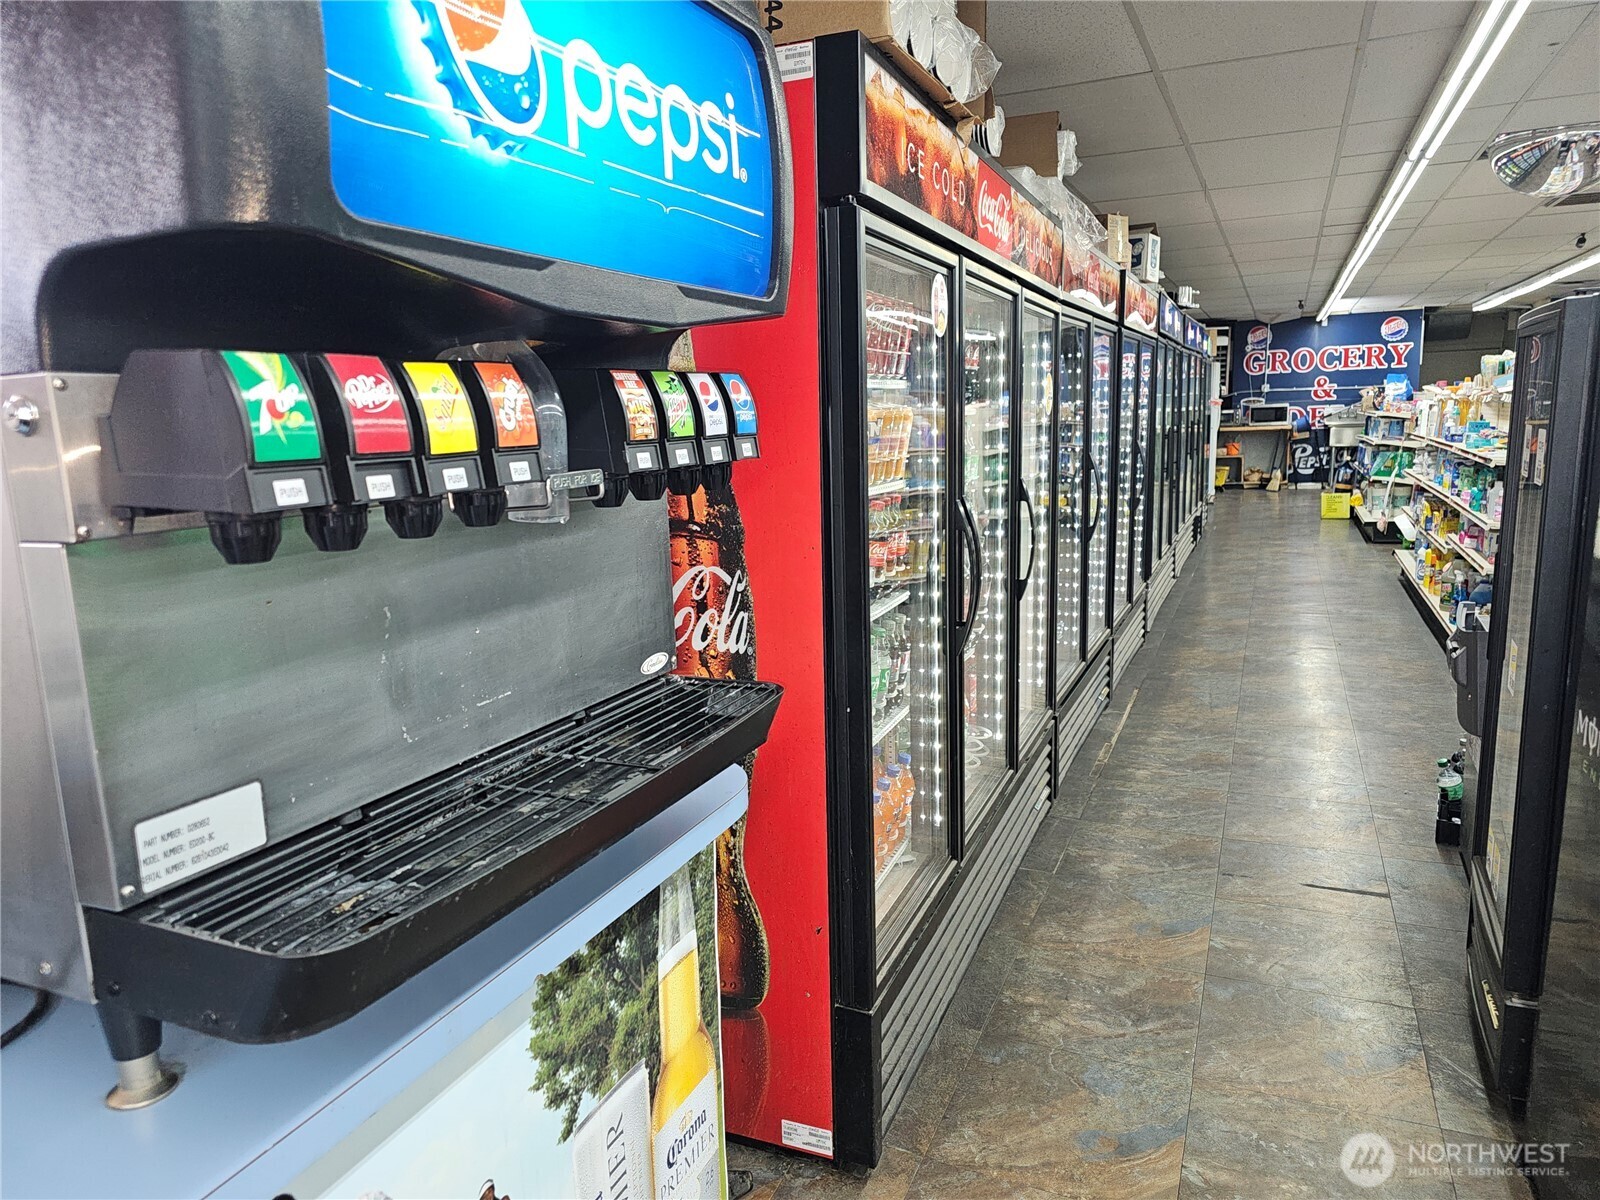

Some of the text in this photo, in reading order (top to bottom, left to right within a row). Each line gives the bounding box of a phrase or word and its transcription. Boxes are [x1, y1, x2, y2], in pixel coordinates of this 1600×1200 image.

[901, 136, 966, 207] ICE COLD
[1243, 342, 1414, 376] GROCERY
[1311, 375, 1337, 400] &
[552, 475, 574, 488] PUSH
[574, 474, 589, 487] FOR
[143, 836, 159, 849] PART
[142, 853, 160, 867] MODEL
[667, 1109, 707, 1169] Corona
[661, 1123, 715, 1200] PREMIER
